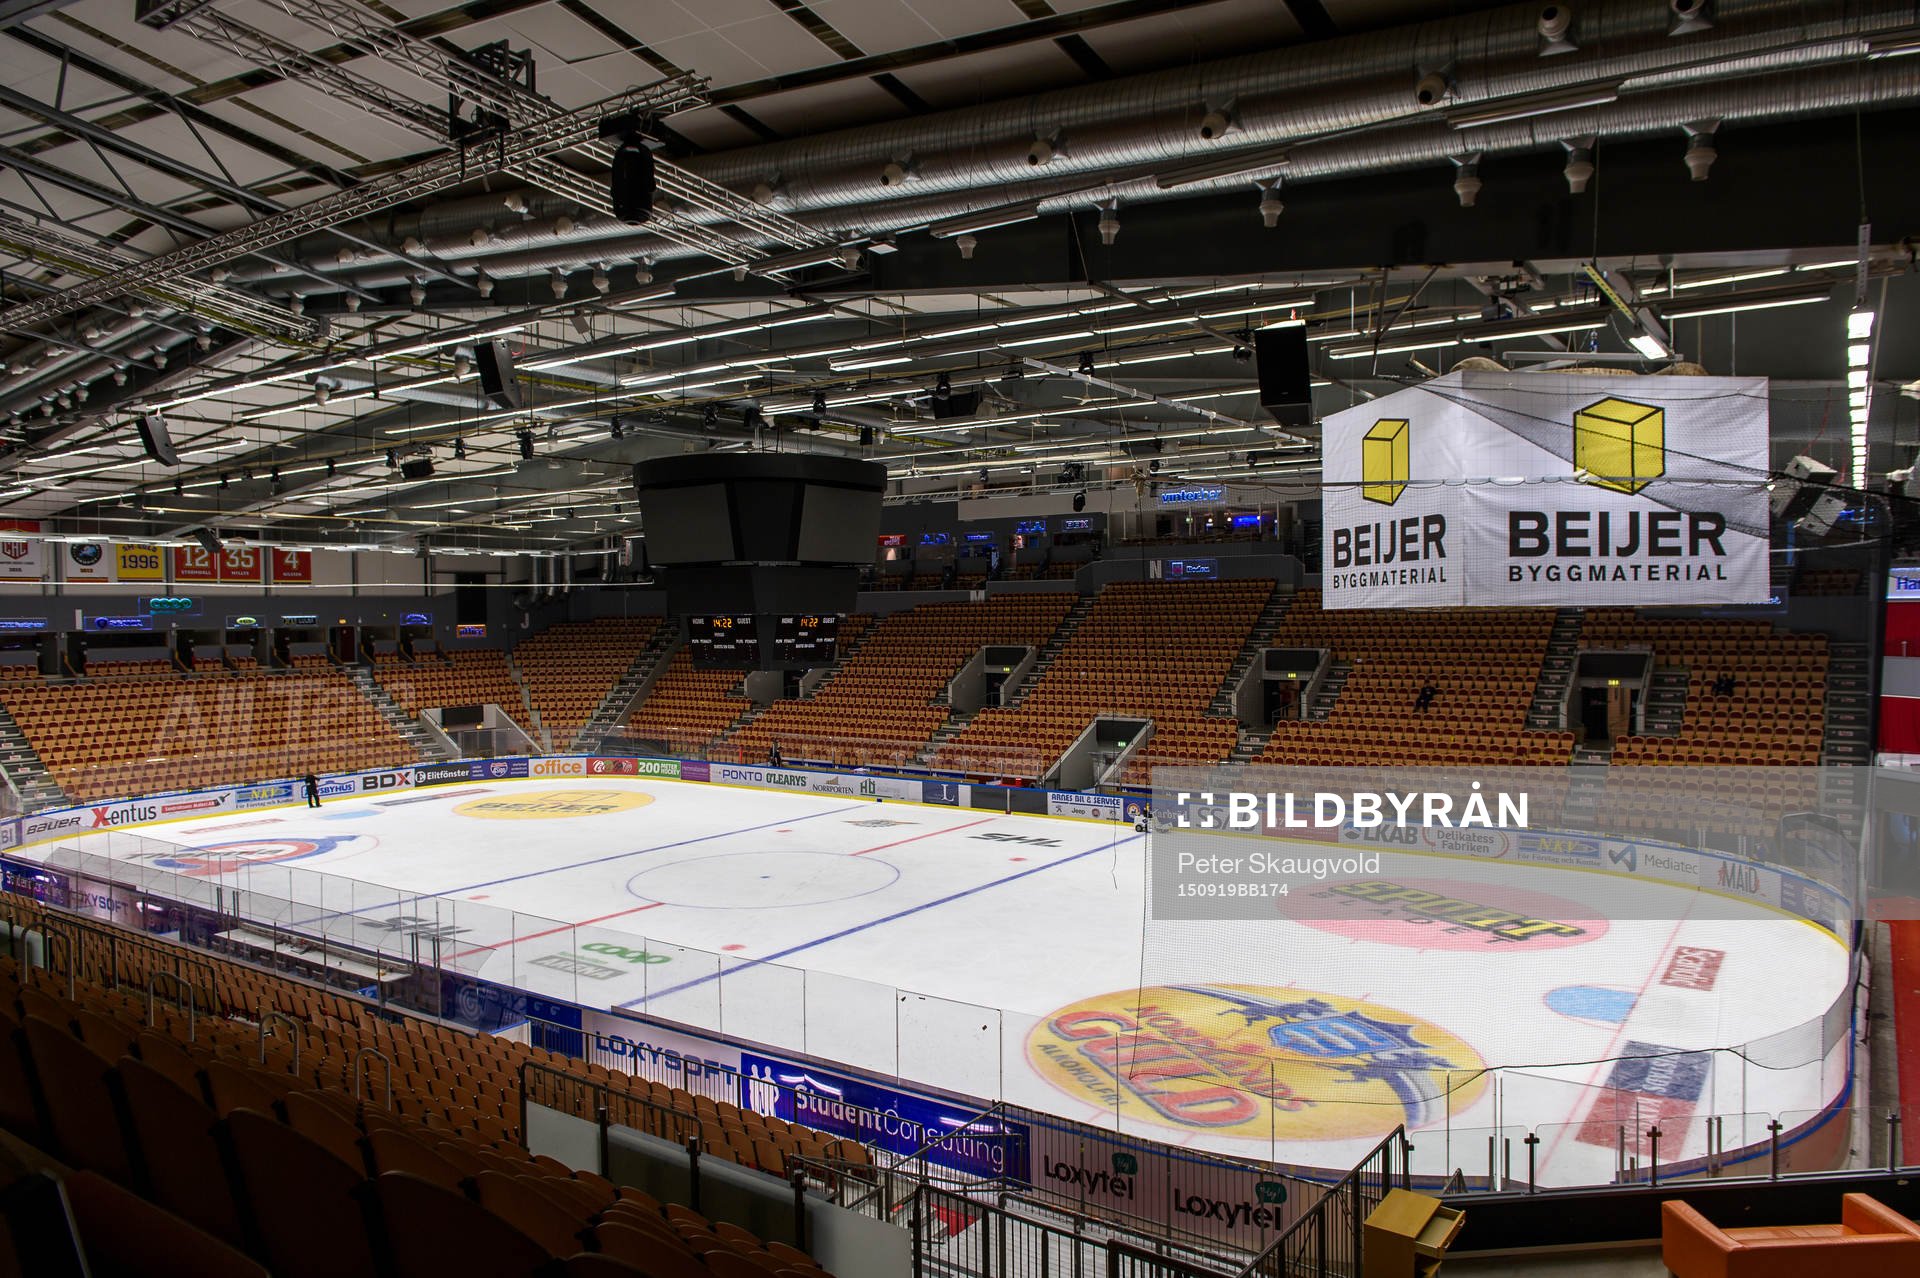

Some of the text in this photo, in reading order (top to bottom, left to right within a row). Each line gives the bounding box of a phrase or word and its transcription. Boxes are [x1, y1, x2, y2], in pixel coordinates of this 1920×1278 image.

[1333, 513, 1447, 568] BEIJER
[1508, 511, 1727, 557] BEIJER
[120, 554, 159, 569] 1996
[183, 547, 209, 567] 12
[226, 548, 254, 568] 35
[284, 550, 298, 569] 4
[1333, 566, 1447, 589] BYGGMATERIAL
[1508, 564, 1728, 582] BYGGMATERIAL
[427, 768, 470, 780] Elitfönster
[533, 760, 582, 774] office
[638, 762, 660, 773] 200
[722, 769, 763, 781] PONTO
[362, 771, 412, 790] BDX
[766, 773, 808, 786] O'LEARYS
[812, 784, 854, 795] NORRPORTEN
[1051, 793, 1073, 802] ARNES
[1074, 795, 1085, 803] BIL
[1093, 797, 1121, 806] SERVICE
[1363, 827, 1418, 845] LKAB
[1437, 829, 1495, 845] Delikatess
[1441, 840, 1490, 854] Fabriken
[1644, 854, 1699, 875] Mediatec
[1331, 880, 1587, 941] SPORT
[581, 942, 673, 964] coop
[594, 1030, 738, 1086] LOXYSOFT
[1124, 1003, 1318, 1112] NORRLANDS
[1037, 1043, 1127, 1107] ALKOHOLFRI
[1048, 1010, 1260, 1127] GULD
[1044, 1154, 1134, 1200] Loxytel
[1174, 1187, 1281, 1231] Loxytel
